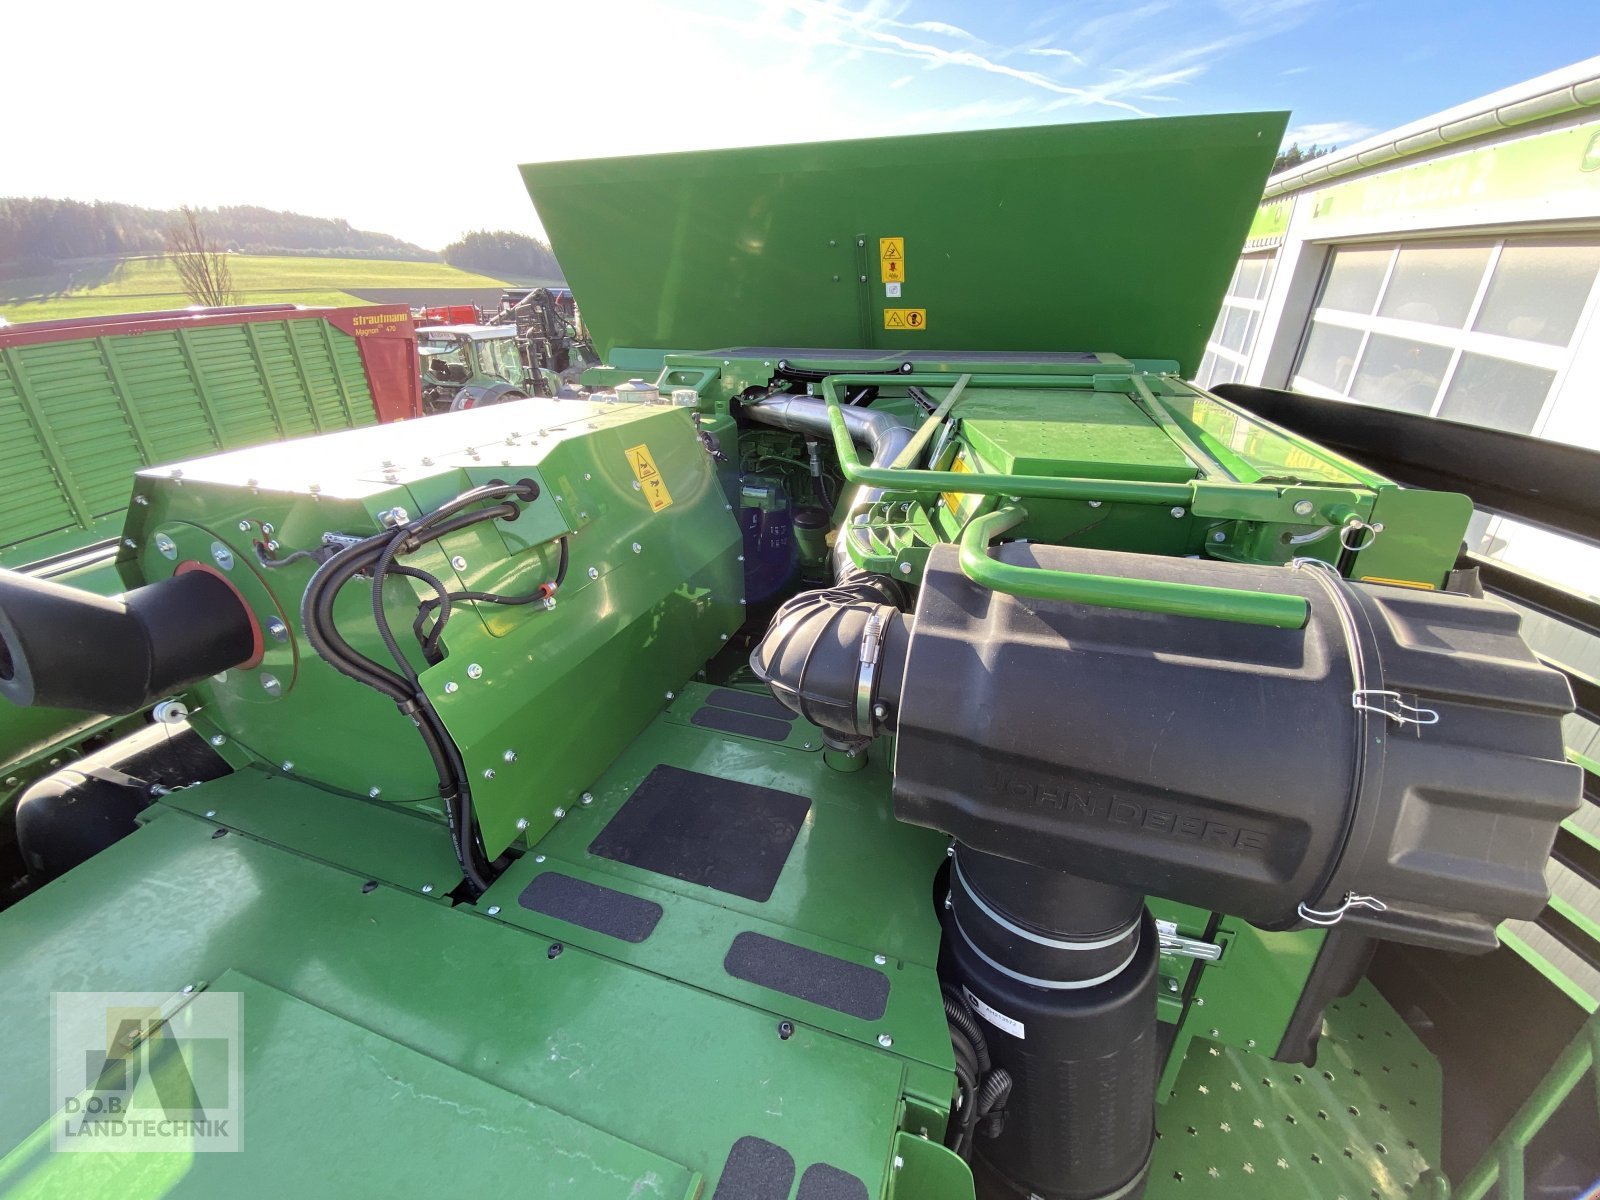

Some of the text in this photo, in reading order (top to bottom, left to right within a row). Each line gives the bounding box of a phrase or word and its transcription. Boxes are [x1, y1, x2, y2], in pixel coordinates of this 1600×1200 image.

[353, 313, 408, 326] strautmann
[355, 327, 379, 337] Magnon
[981, 769, 1270, 850] JOHN DEERE
